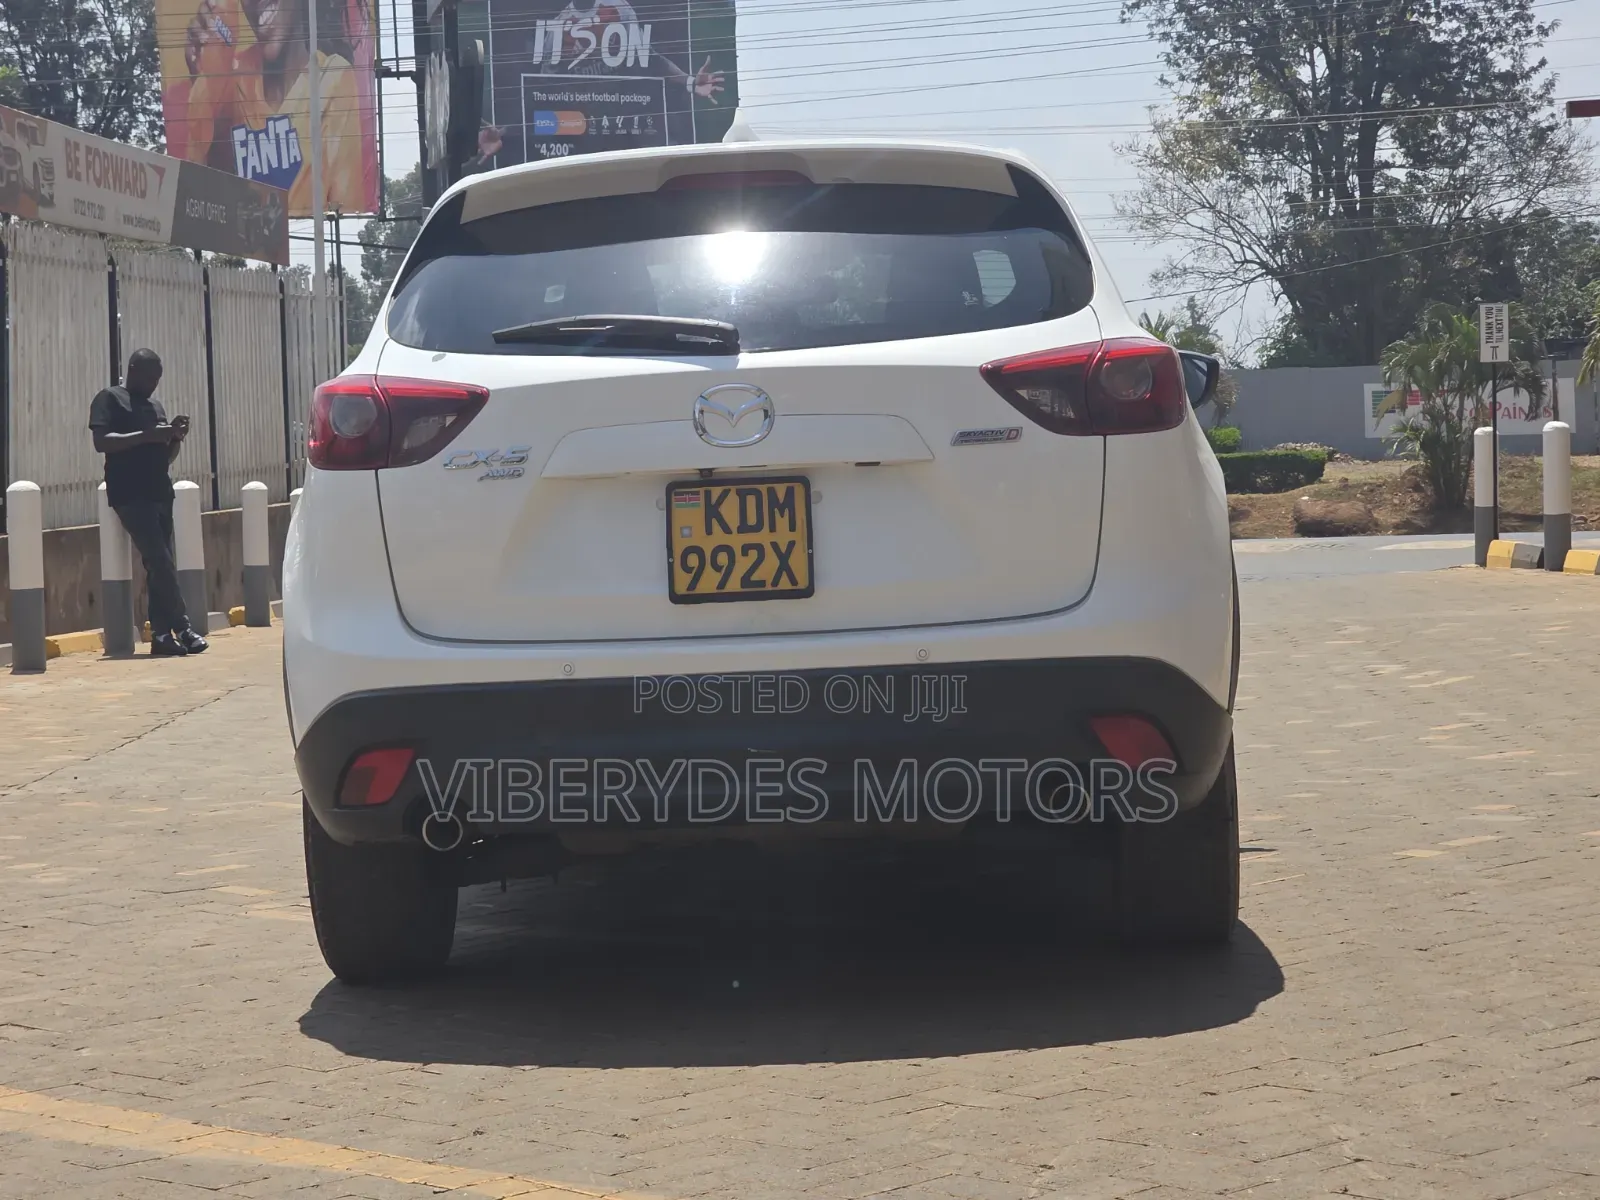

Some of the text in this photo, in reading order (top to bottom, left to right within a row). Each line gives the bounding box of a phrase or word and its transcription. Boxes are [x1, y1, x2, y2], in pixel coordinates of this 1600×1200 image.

[532, 18, 652, 70] IT'S ON
[533, 91, 651, 105] The world's best football package
[232, 117, 302, 180] FANTA
[540, 143, 569, 157] 4,200
[65, 137, 148, 200] BE FORWARD
[185, 198, 227, 224] AGENT OFFICE
[1485, 306, 1494, 344] THANK YOU
[1495, 318, 1504, 334] NEXT
[1005, 428, 1020, 441] D
[443, 445, 532, 470] CX-5
[477, 467, 525, 482] AWD
[704, 485, 797, 536] KDM
[680, 540, 799, 592] 992X
